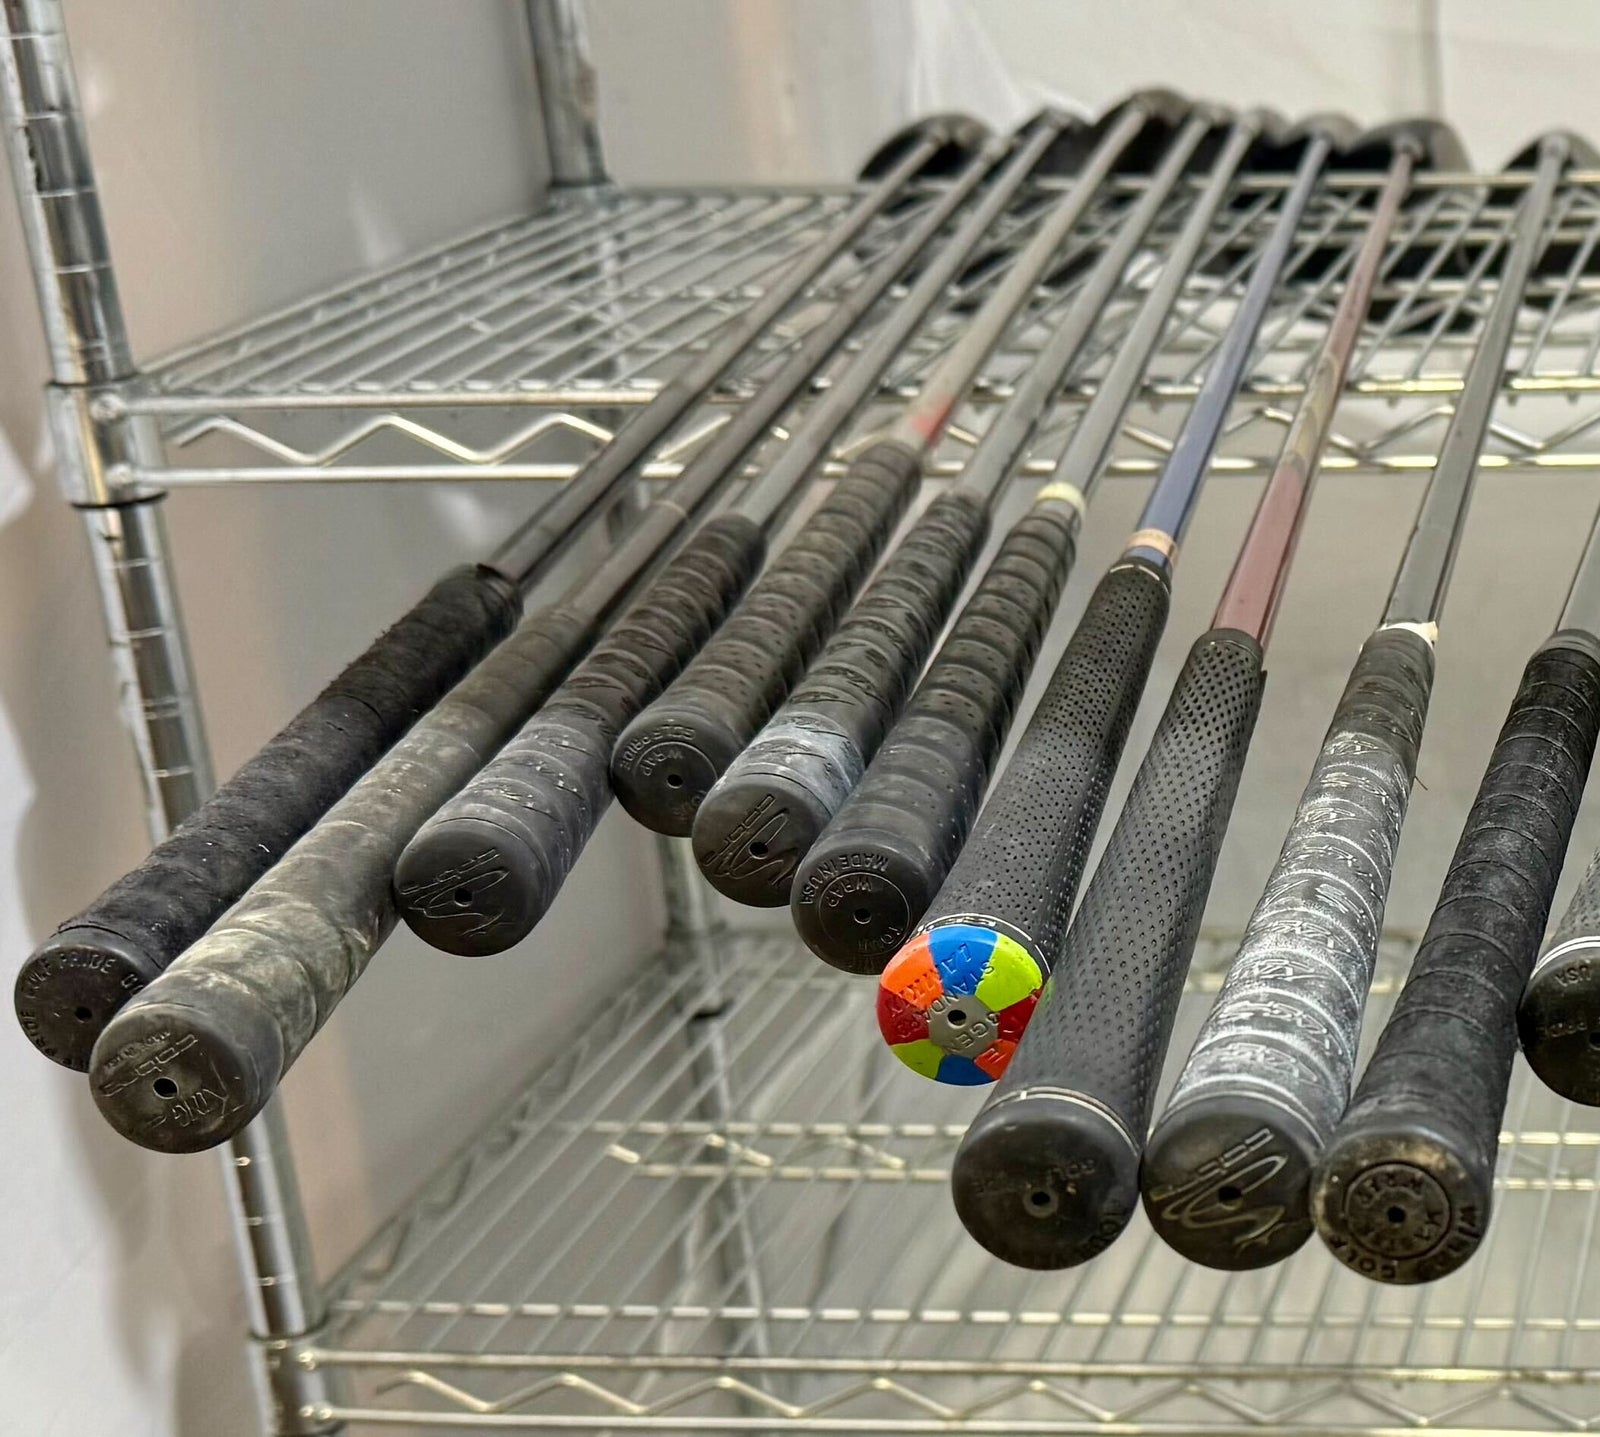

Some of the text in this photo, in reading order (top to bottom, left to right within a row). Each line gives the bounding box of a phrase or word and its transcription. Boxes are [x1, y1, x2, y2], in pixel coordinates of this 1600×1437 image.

[798, 852, 889, 905] MADE IN USA
[824, 876, 872, 907] WRAP
[1555, 965, 1592, 989] USA
